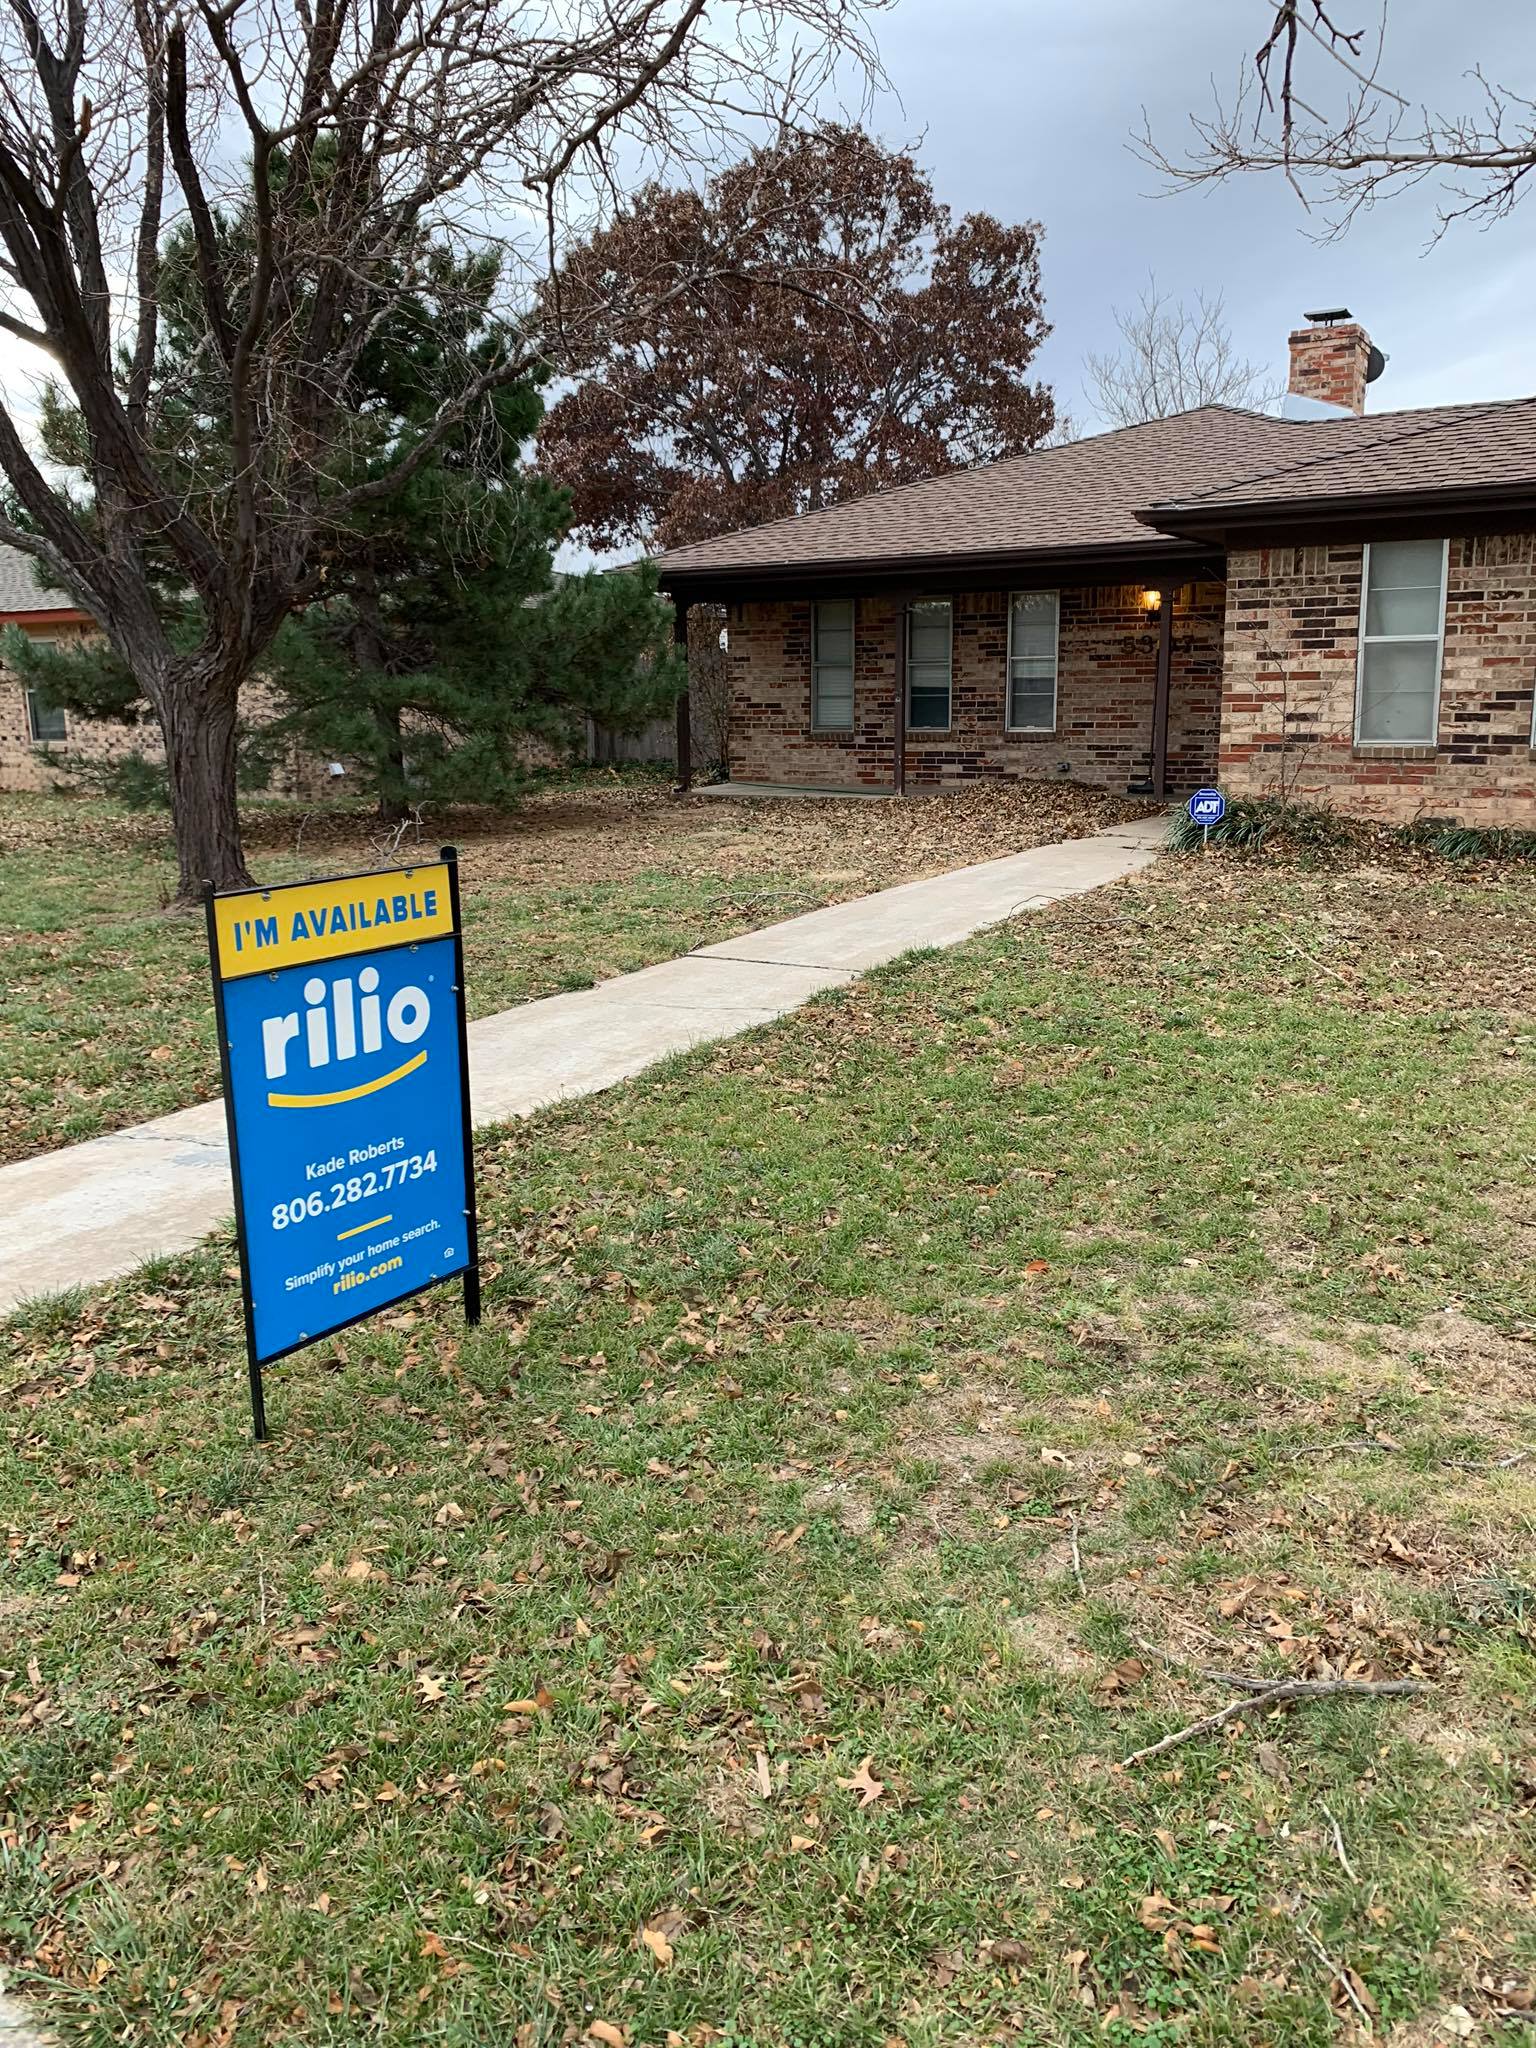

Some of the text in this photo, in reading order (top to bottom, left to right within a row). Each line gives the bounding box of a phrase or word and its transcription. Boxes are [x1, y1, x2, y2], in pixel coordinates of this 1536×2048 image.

[1195, 800, 1219, 814] ADT
[234, 890, 438, 952] I'M AVAILABLE
[262, 966, 431, 1080] rilio
[306, 1136, 406, 1181] Kade Roberts
[271, 1150, 438, 1231] 806.282.7734
[284, 1218, 442, 1292] Simplify your home search.
[332, 1255, 404, 1296] rilio.com
